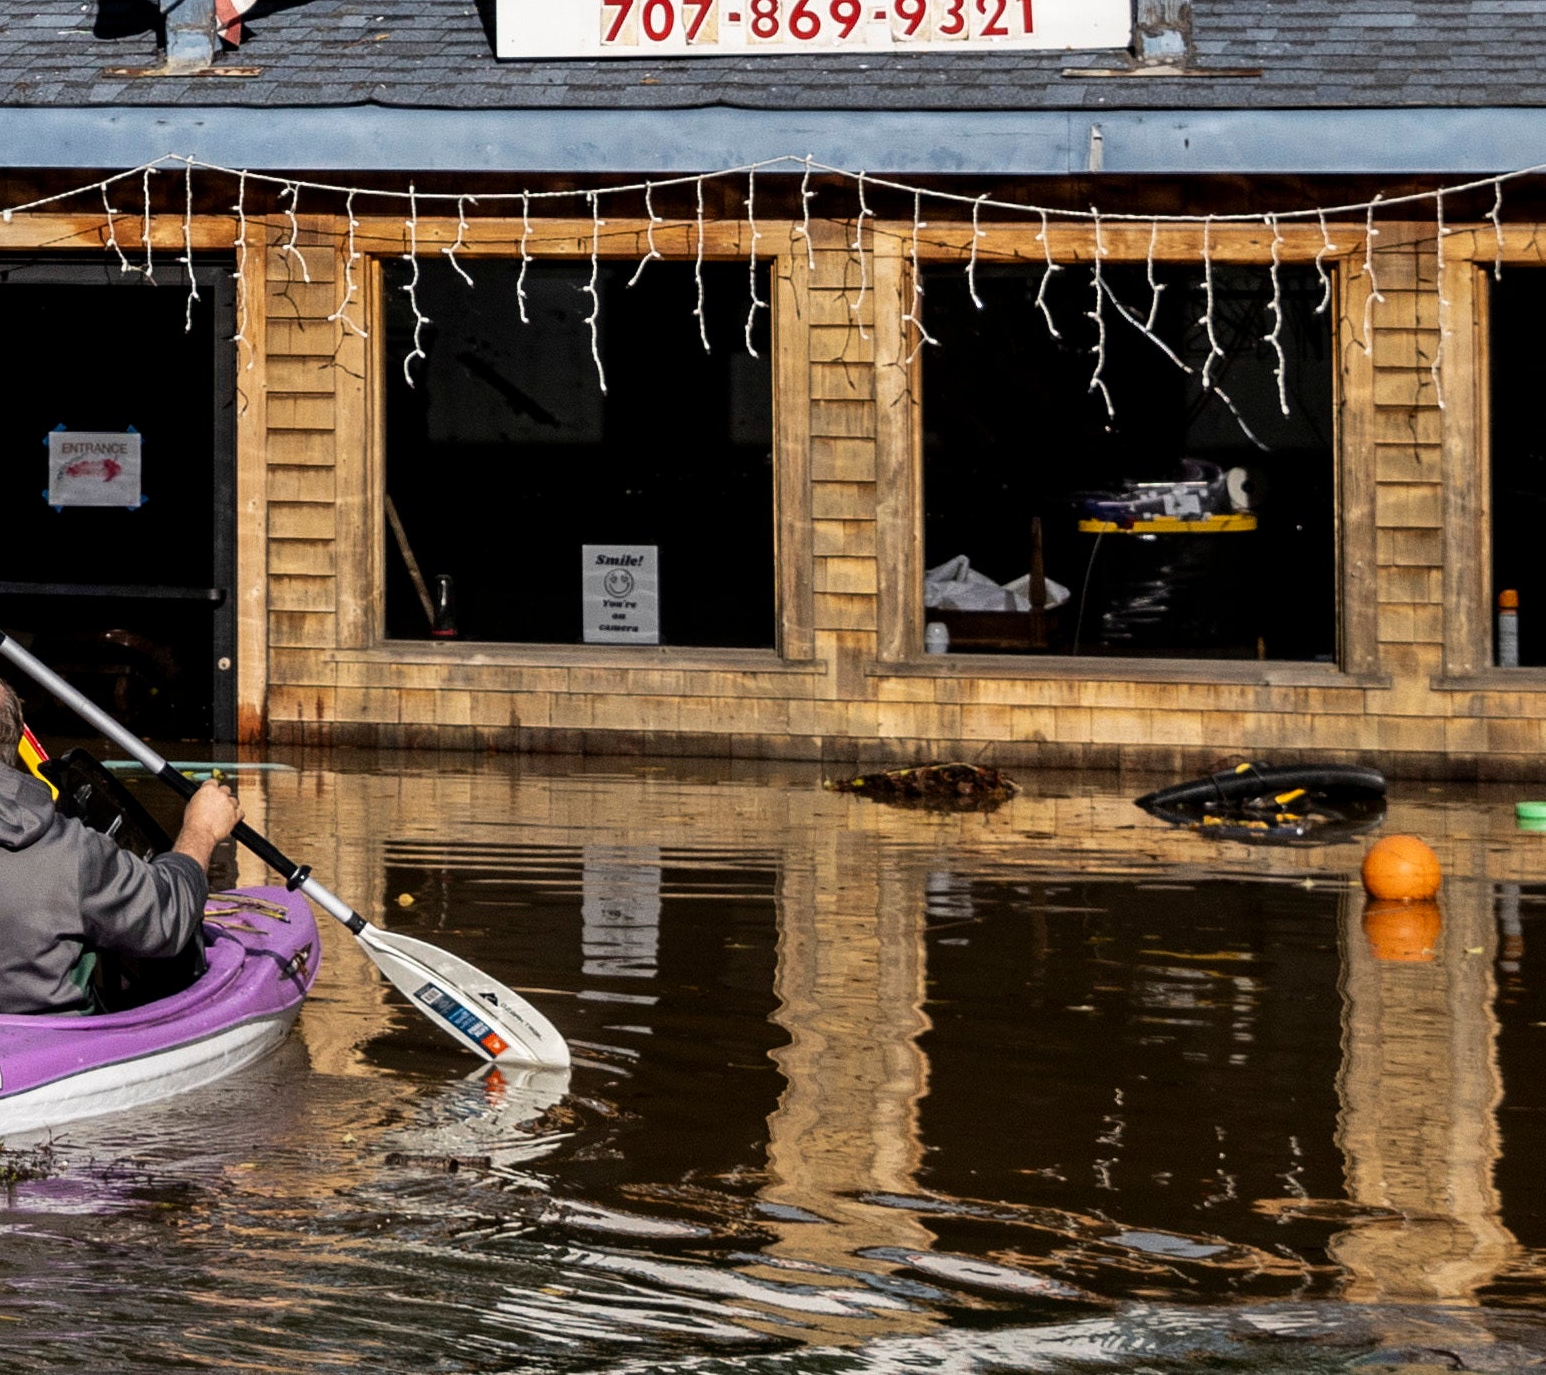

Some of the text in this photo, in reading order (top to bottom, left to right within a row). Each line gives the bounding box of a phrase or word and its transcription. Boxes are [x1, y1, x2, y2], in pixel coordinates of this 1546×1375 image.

[61, 442, 128, 455] ENTRANCE
[595, 554, 644, 567] Smile!
[602, 599, 638, 609] You're
[611, 612, 627, 620] on
[598, 623, 639, 633] camera
